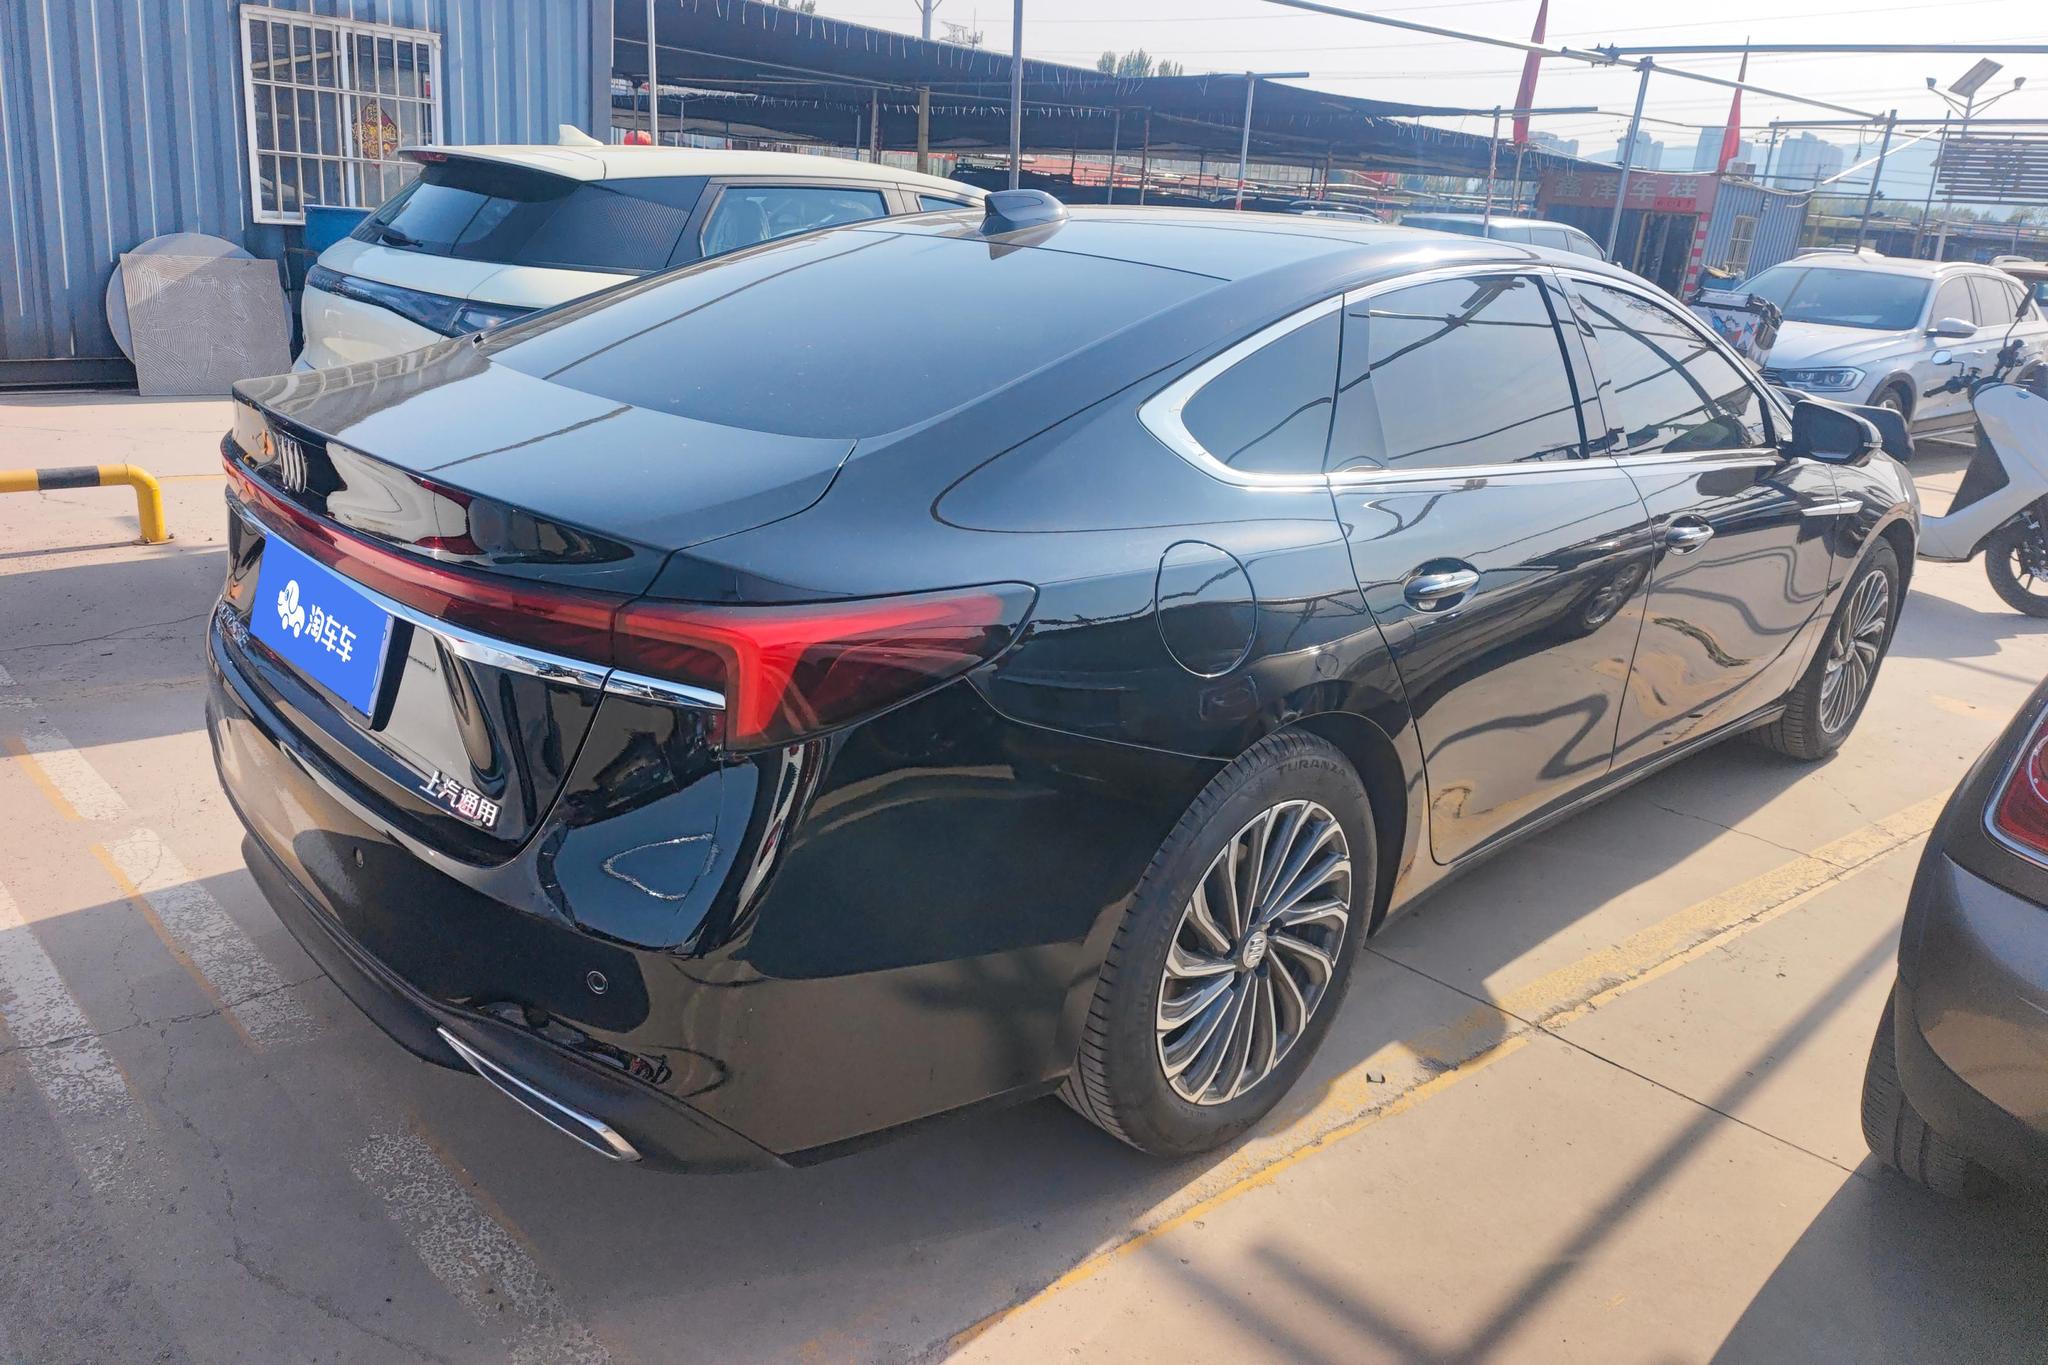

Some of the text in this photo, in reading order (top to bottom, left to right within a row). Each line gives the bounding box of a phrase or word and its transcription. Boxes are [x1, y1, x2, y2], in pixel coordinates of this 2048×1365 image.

[1276, 759, 1346, 777] TURANZA
[419, 769, 499, 827] 上汽通用
